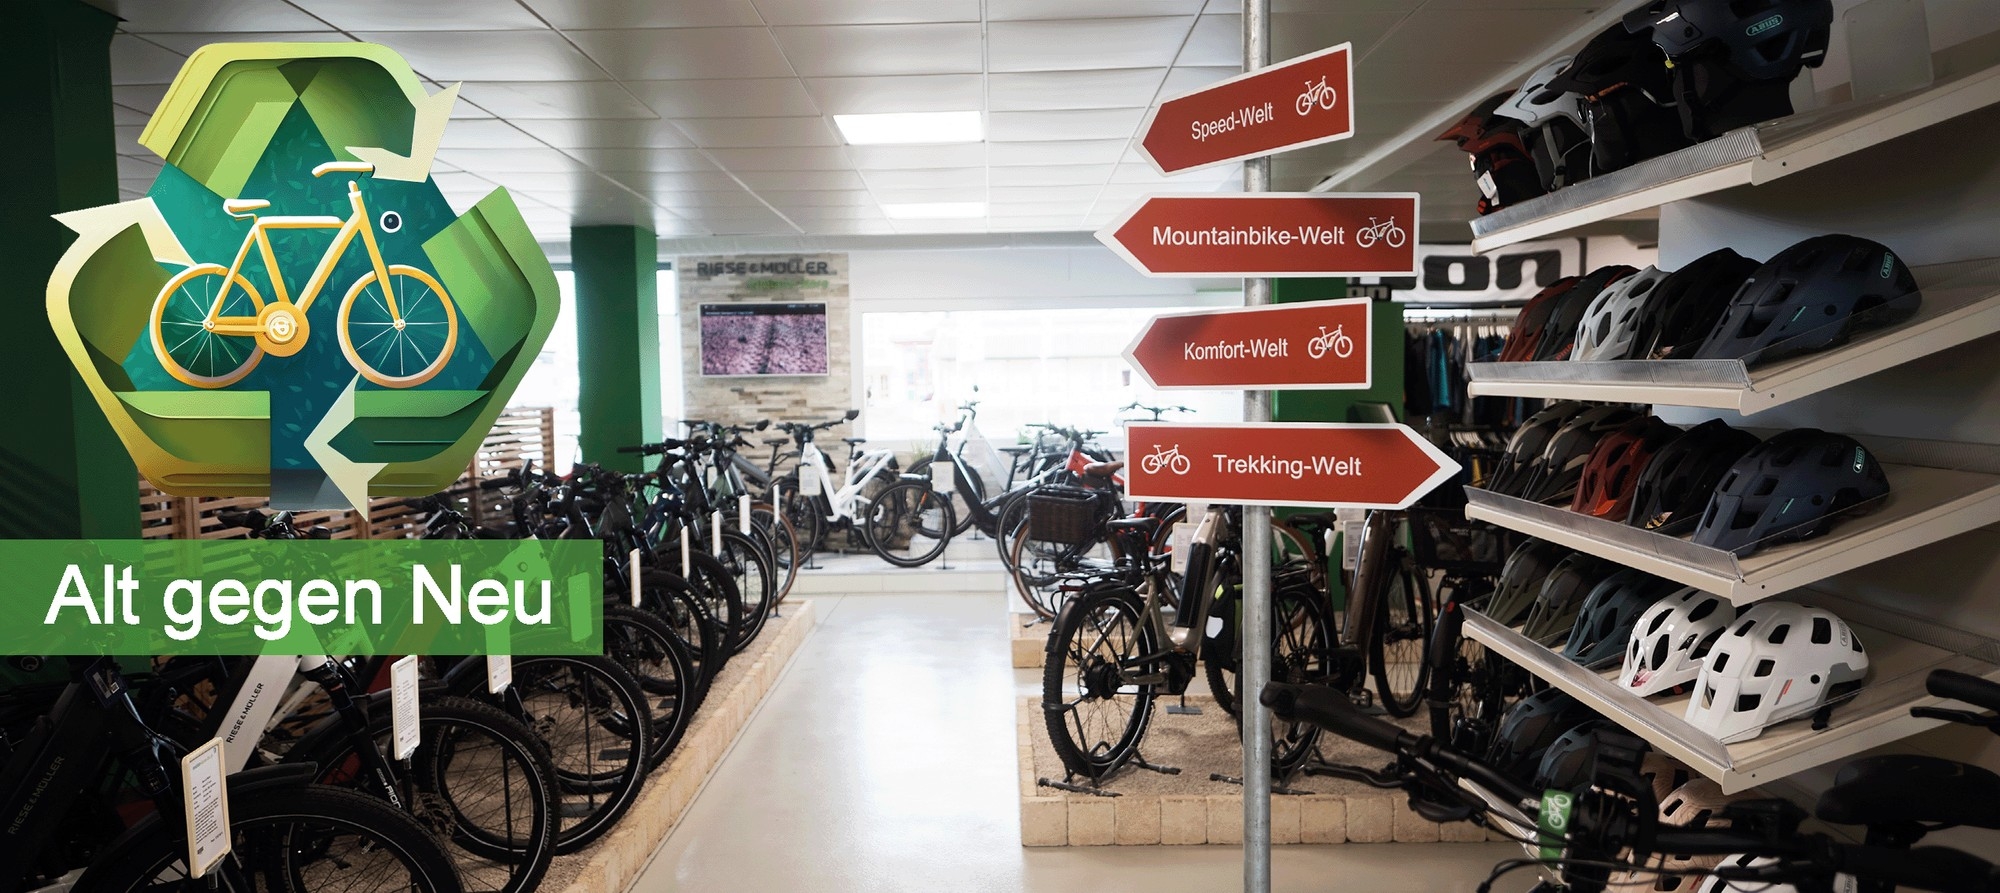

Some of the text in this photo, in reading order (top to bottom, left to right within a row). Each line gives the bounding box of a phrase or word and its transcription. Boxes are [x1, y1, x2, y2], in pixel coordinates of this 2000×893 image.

[1191, 102, 1274, 142] Speed-Welt
[1152, 224, 1345, 247] Mountainbike-Welt
[697, 262, 747, 275] RIESE
[1184, 338, 1289, 360] Komfort-Welt
[1212, 453, 1363, 479] Trekking-Welt
[226, 719, 243, 744] RIESE
[7, 803, 34, 835] RIESE
